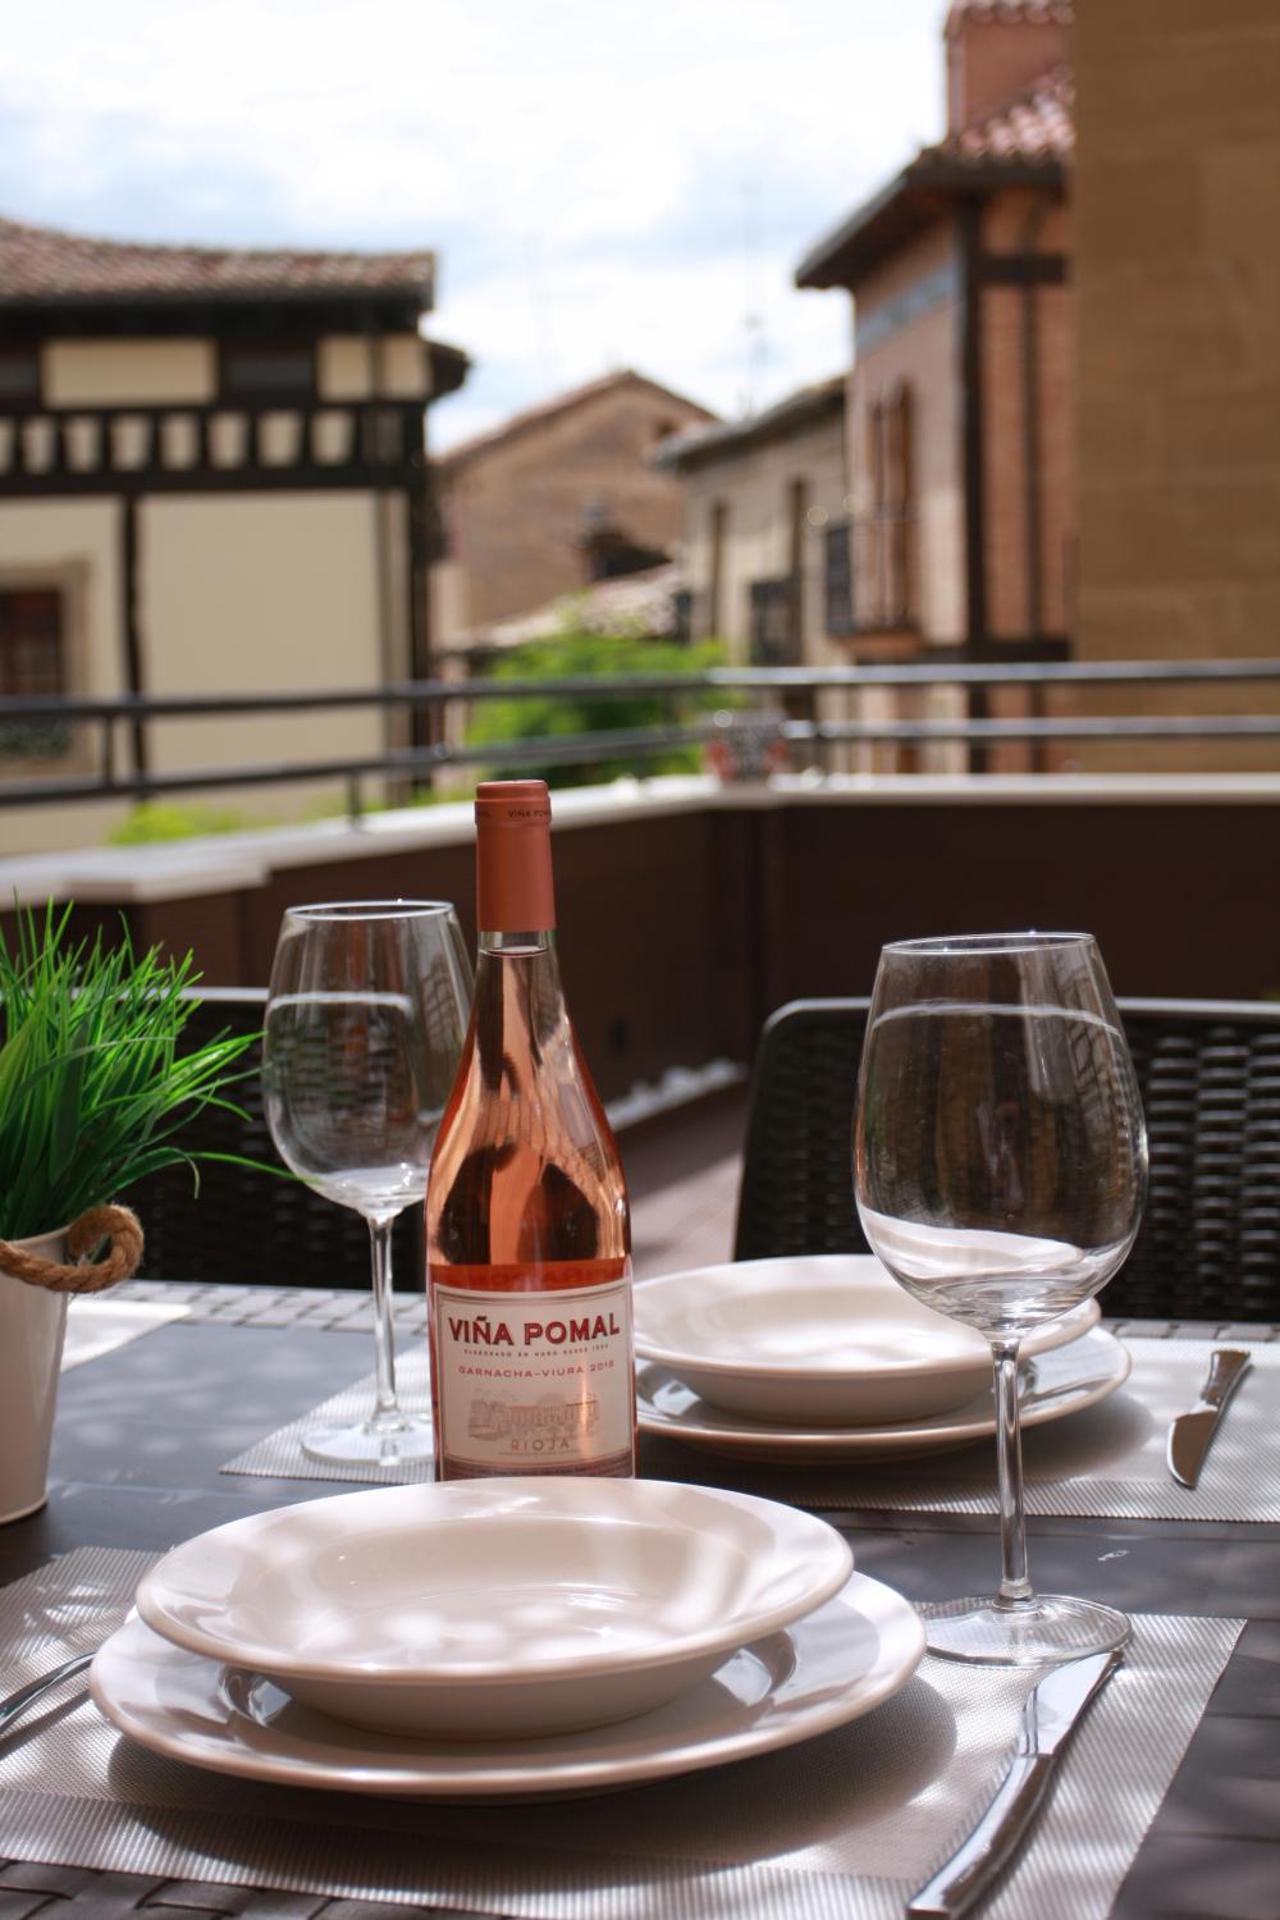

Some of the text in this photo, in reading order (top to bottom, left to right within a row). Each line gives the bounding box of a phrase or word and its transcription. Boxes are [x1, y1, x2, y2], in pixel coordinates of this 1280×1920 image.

[447, 1312, 621, 1346] VIÑA POMAL
[457, 1364, 585, 1378] GARNACHA-VIURA
[510, 1437, 570, 1452] RIOJA
